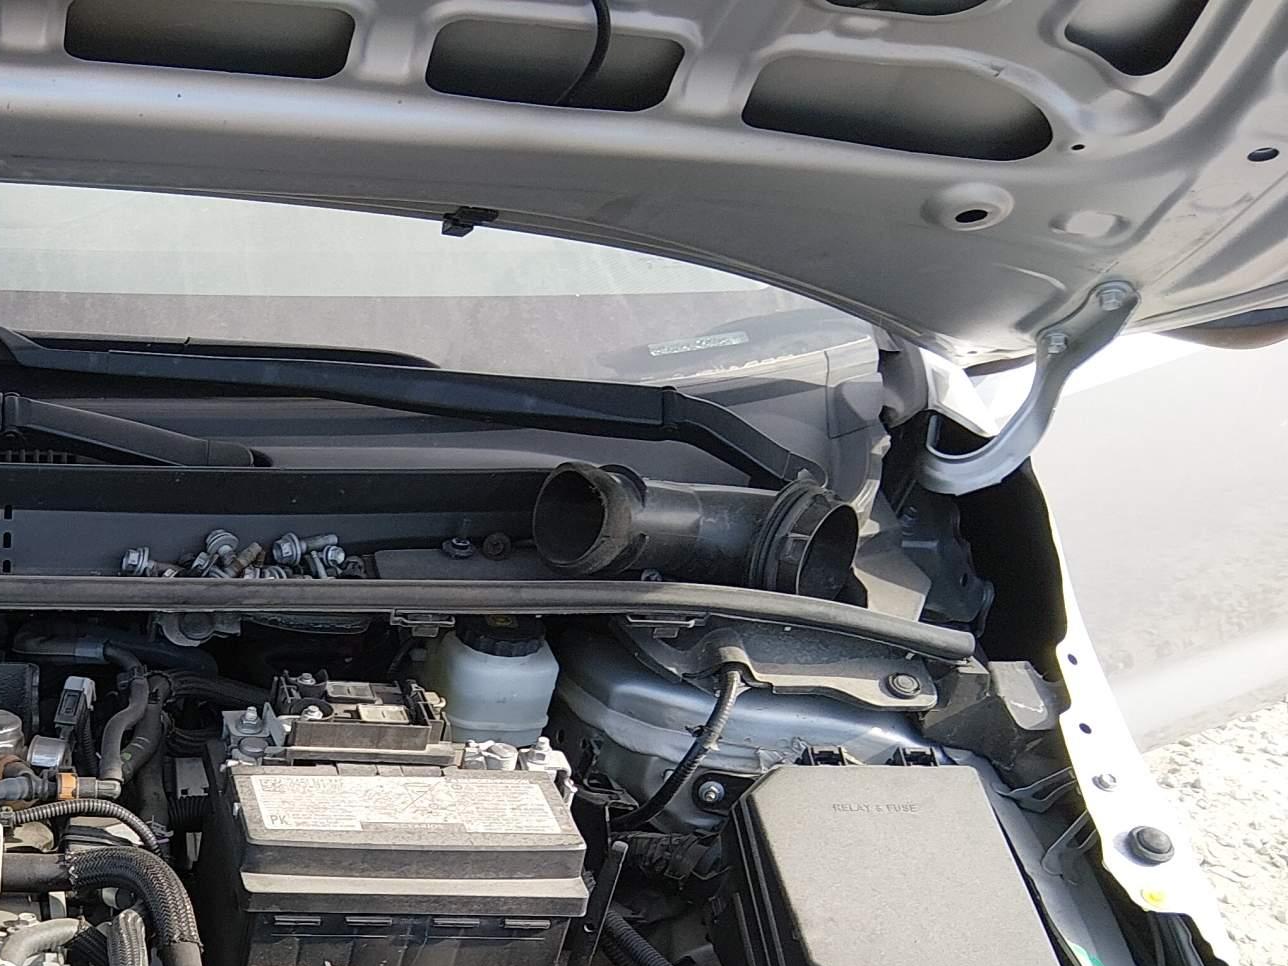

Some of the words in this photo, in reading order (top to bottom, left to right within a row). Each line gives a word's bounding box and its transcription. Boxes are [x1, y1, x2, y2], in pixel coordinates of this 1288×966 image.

[832, 803, 870, 813] RELAY
[886, 803, 919, 814] FUSE
[270, 815, 289, 826] PK
